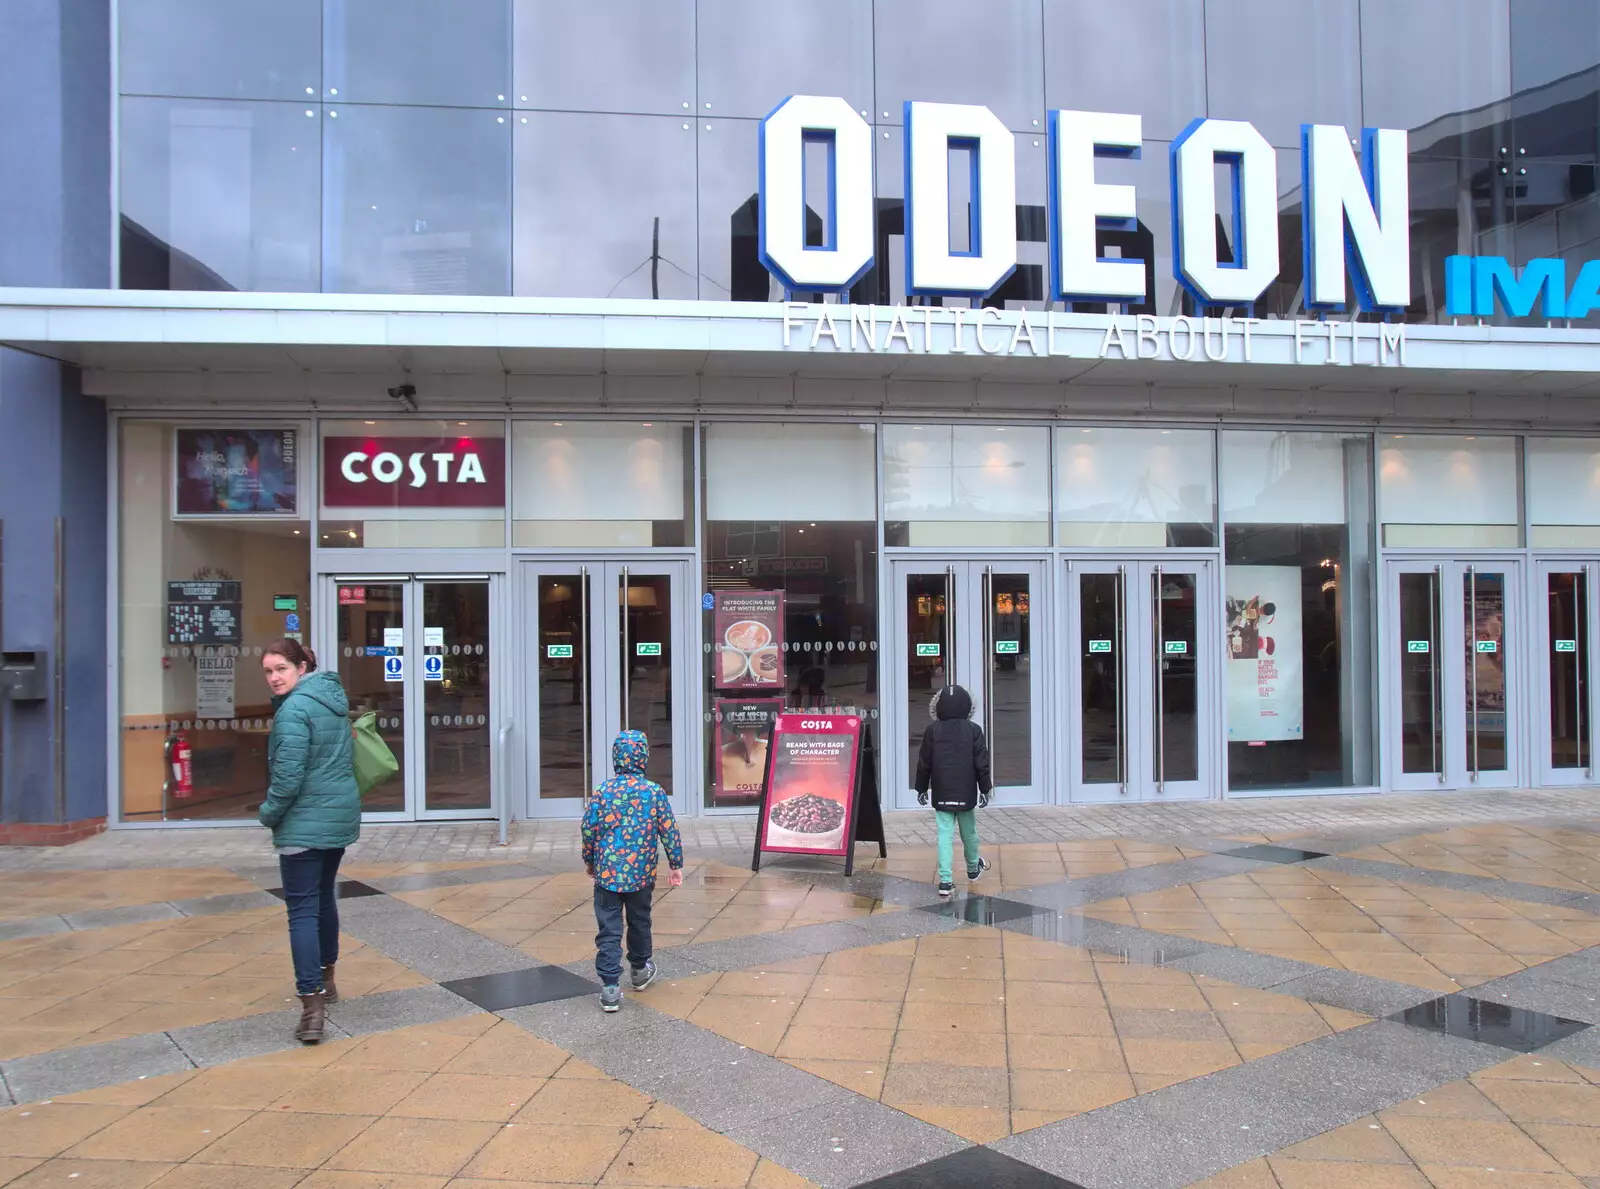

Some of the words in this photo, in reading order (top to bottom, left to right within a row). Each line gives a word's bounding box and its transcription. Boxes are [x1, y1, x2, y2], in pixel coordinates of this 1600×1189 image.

[759, 95, 1410, 312] ODEON
[783, 299, 1071, 356] FANATICAL
[1099, 310, 1260, 361] ABOUT
[1294, 319, 1406, 367] FILM
[283, 431, 293, 463] ODEON
[341, 451, 487, 488] COSTA
[199, 658, 233, 669] HELLO
[801, 720, 832, 730] COSTA
